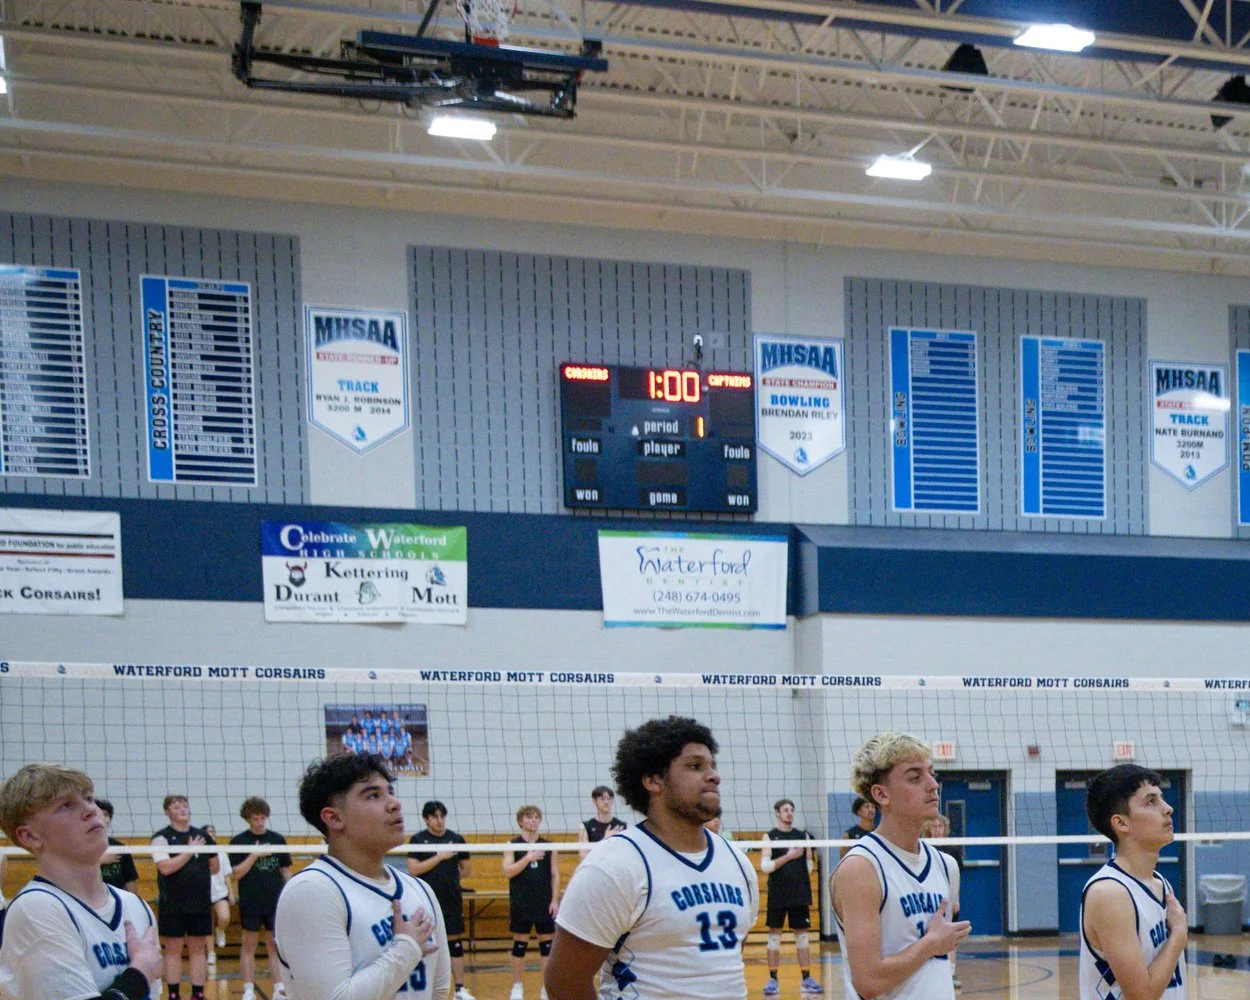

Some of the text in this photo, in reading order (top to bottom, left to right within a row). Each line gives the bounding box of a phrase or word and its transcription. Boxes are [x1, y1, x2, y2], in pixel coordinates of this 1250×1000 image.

[314, 315, 399, 353] MHSAA
[761, 343, 838, 380] MHSAA
[147, 309, 170, 451] CROSS COUNTRY
[337, 379, 379, 393] TRACK
[649, 370, 700, 402] 1:00
[1156, 368, 1222, 398] MHSAA
[316, 394, 340, 402] RYAN
[354, 397, 401, 405] ROBINSON
[770, 394, 830, 408] BOWLING
[370, 406, 391, 414] 2014
[761, 408, 839, 421] BRENDAN RILEY
[895, 392, 907, 446] BOWLING
[1025, 400, 1036, 452] BOWLING
[1170, 414, 1209, 425] TRACK
[644, 420, 679, 434] period
[697, 416, 704, 438] 1
[1155, 428, 1224, 440] NATE BURNAND
[571, 438, 599, 453] fouls
[644, 443, 680, 457] player
[724, 444, 750, 459] fouls
[1177, 440, 1204, 449] 3200M
[1180, 450, 1200, 459] 2013
[576, 489, 598, 501] won
[650, 492, 677, 506] game
[728, 494, 749, 506] won
[8, 540, 55, 548] FOUNDATION
[280, 524, 447, 550] Celebrate Waterford
[299, 550, 440, 560] HIGH SCHOOLS
[636, 546, 751, 576] Waterford
[324, 562, 408, 580] Kettering
[646, 578, 744, 587] DENTIST
[275, 584, 459, 605] Durant Mott
[653, 591, 741, 604] (248) 674-0495
[113, 665, 326, 680] WATERFORD MOTT CORSAIRS
[420, 671, 615, 683] WATERFORD MOTT CORSAIRS
[702, 674, 882, 686] WATERFORD MOTT CORSAIRS
[962, 677, 1129, 688] WATERFORD MOTT CORSAIRS
[671, 882, 744, 911] CORSAIRS
[696, 910, 738, 952] 13
